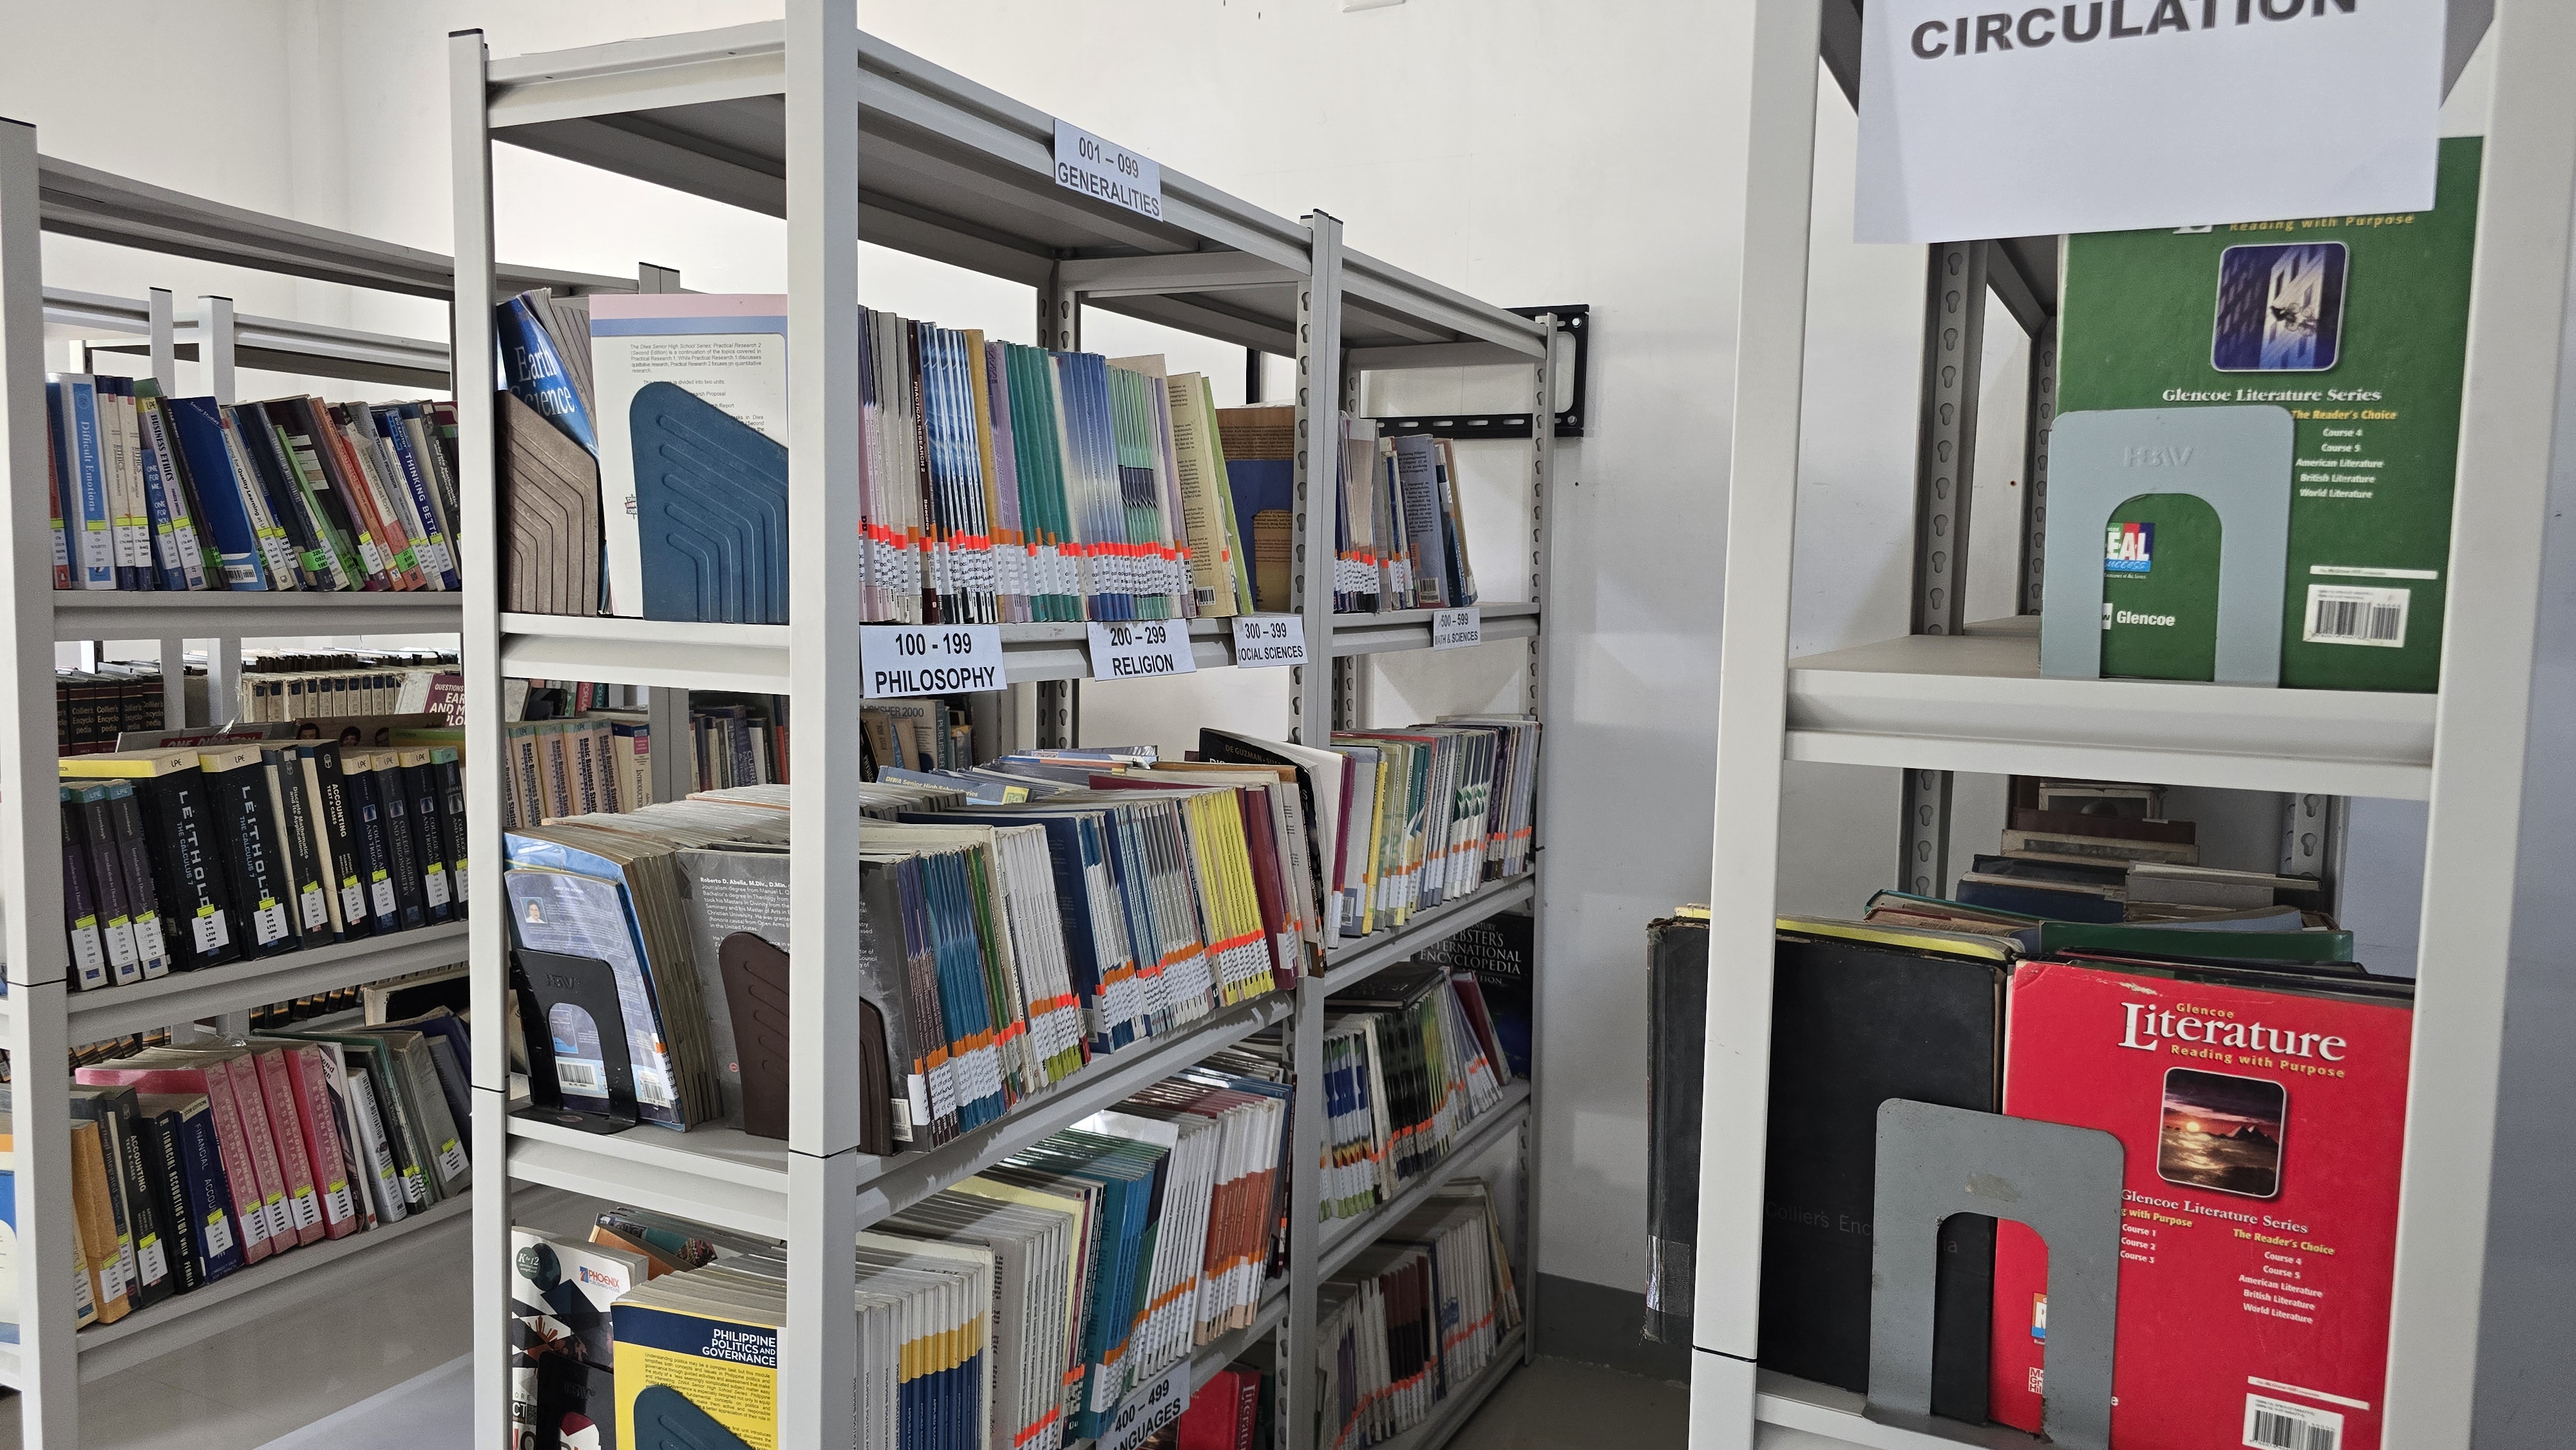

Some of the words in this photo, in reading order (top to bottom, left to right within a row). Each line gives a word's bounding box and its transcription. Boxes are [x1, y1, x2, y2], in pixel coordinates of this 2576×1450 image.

[1079, 137, 1101, 164] 001
[1117, 153, 1139, 179] 099
[1058, 162, 1160, 217] GENERALITIES
[2302, 217, 2338, 229] with
[2345, 214, 2415, 228] Purpose
[515, 340, 557, 383] Earth
[509, 385, 576, 417] cience
[2162, 389, 2230, 402] Glencoe
[2235, 389, 2322, 402] Literature
[2326, 388, 2383, 402] Series
[190, 401, 203, 413] Social
[202, 410, 220, 426] Studies
[2291, 410, 2311, 419] The
[2313, 410, 2358, 420] Reader's
[2361, 410, 2398, 420] Choice
[80, 421, 93, 462] Difficult
[150, 414, 166, 452] BUSINESS
[160, 453, 175, 482] ETHICS
[375, 437, 386, 461] TEACHING
[85, 465, 96, 512] Emotions
[238, 468, 249, 491] Quality
[246, 490, 260, 517] Learning
[405, 452, 426, 502] THINKING
[422, 505, 438, 537] BETTE
[2106, 532, 2150, 561] EAL
[1441, 614, 1452, 628] 500
[1457, 612, 1469, 625] 599
[2117, 610, 2175, 626] Glencoe
[1110, 626, 1132, 646] 200
[1144, 626, 1166, 645] 299
[1245, 623, 1261, 639] 300
[1271, 623, 1287, 637] 399
[1452, 631, 1479, 643] SCIENCES
[895, 634, 926, 656] 100
[943, 634, 972, 655] 199
[1238, 646, 1264, 661] SOCIAL
[1264, 645, 1303, 660] SCIENCES
[1112, 654, 1174, 676] RELIGION
[875, 666, 996, 694] PHILOSOPHY
[430, 702, 454, 714] AND
[902, 708, 924, 717] 2000
[1226, 744, 1234, 753] DE
[1235, 748, 1262, 762] GUZMAN
[585, 758, 594, 792] Business
[332, 783, 347, 838] ACCOUNTING
[292, 786, 301, 814] Discrete
[298, 816, 308, 860] Mathematics
[294, 815, 304, 857] Applications
[242, 833, 254, 872] CALCULUS
[399, 820, 410, 855] COLLEGE
[406, 857, 415, 892] ALGEBRA
[395, 836, 409, 896] TRIGONOMETRY
[1453, 929, 1504, 948] EBSTER'S
[1420, 950, 1520, 974] ENCYCLOPEDIA
[2175, 1003, 2235, 1020] Glencoe
[2118, 1001, 2347, 1062] Literature
[2171, 1044, 2233, 1065] Reading
[2239, 1054, 2275, 1069] with
[2279, 1059, 2347, 1080] Purpose
[362, 1075, 374, 1107] INTRINSIC
[370, 1105, 384, 1140] MOTIVATION
[195, 1123, 206, 1172] FINANCIAL
[131, 1135, 146, 1192] ACCOUNTING
[162, 1131, 175, 1171] FINANCIAL
[169, 1171, 184, 1218] ACCOUNTING
[177, 1215, 187, 1235] TWO
[2121, 1188, 2179, 1210] Glencoe
[2183, 1199, 2259, 1227] Literature
[2262, 1214, 2309, 1234] Series
[2129, 1208, 2151, 1220] with
[2152, 1212, 2193, 1229] Purpose
[2122, 1224, 2149, 1237] Course
[2152, 1229, 2157, 1238] 1
[2233, 1229, 2252, 1241] The
[2253, 1231, 2298, 1249] Reader's
[2300, 1239, 2336, 1256] Choice
[2121, 1237, 2148, 1250] Course
[2150, 1242, 2157, 1251] 2
[518, 1253, 527, 1263] K
[531, 1256, 539, 1265] 12
[2119, 1250, 2148, 1263] Course
[2148, 1255, 2155, 1265] 3
[2264, 1251, 2293, 1265] Course
[2295, 1257, 2303, 1266] 4
[589, 1270, 620, 1288] PHOENIX
[2262, 1265, 2291, 1278] Course
[2294, 1271, 2302, 1281] 5
[2238, 1273, 2279, 1289] American
[2280, 1281, 2324, 1299] Literature
[2242, 1288, 2272, 1303] British
[2273, 1295, 2316, 1312] Literature
[2242, 1302, 2270, 1315] World
[2271, 1308, 2314, 1324] Literature
[712, 1338, 758, 1354] POLITICS
[714, 1328, 776, 1348] PHILIPPINE
[645, 1352, 673, 1362] Understanding
[702, 1346, 776, 1366] GOVERNANCE
[1115, 1404, 1135, 1433] 400
[1148, 1379, 1170, 1406] 499
[1112, 1397, 1181, 1450] ANGUAGES
